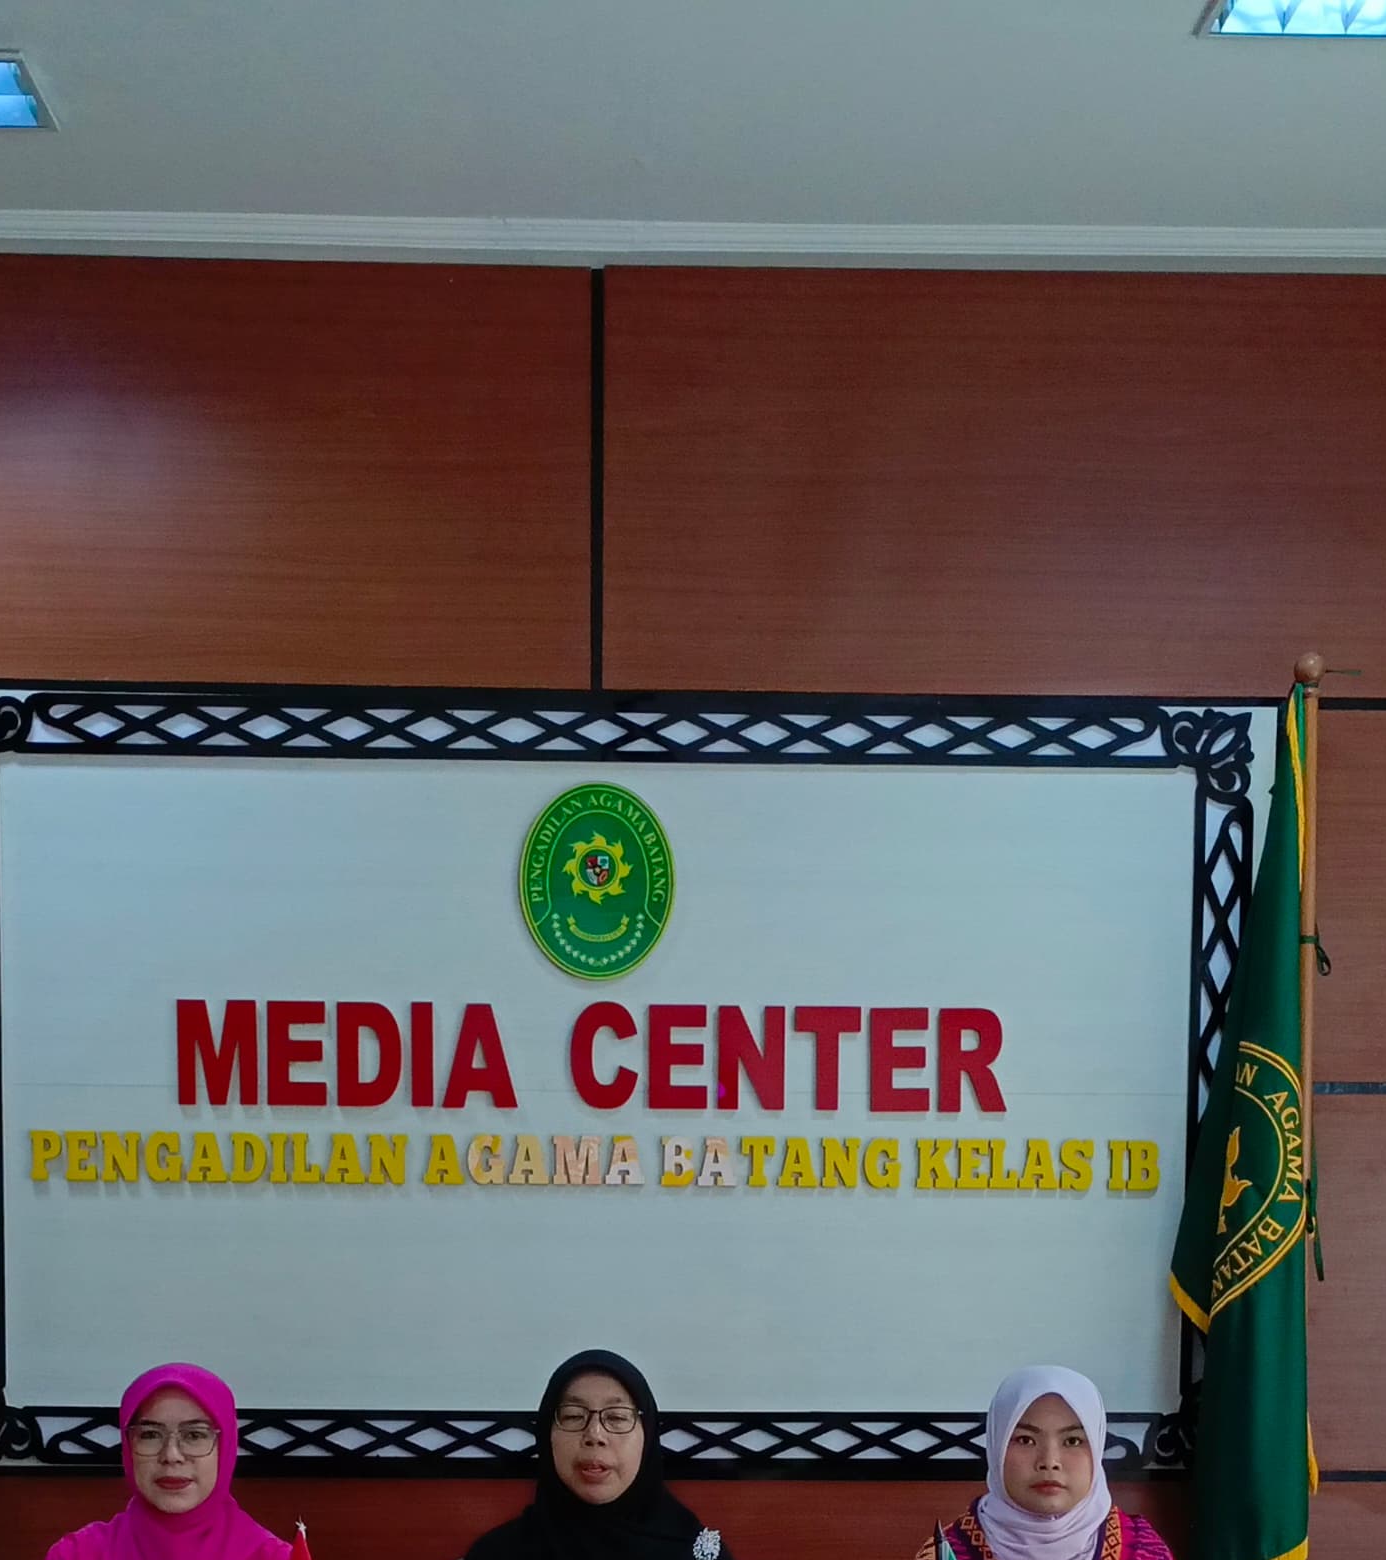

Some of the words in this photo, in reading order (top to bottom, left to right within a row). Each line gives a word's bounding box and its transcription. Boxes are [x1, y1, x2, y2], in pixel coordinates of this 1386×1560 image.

[531, 797, 583, 902] PENGADILAN
[588, 793, 646, 832] AGAMA
[643, 832, 666, 902] BATANG
[176, 999, 518, 1109] MEDIA
[570, 1001, 1007, 1112] CENTER
[29, 1130, 407, 1185] PENGADILAN
[423, 1134, 645, 1187] AGAMA
[661, 1135, 902, 1190] BATANG
[915, 1138, 1094, 1191] KELAS
[1107, 1140, 1160, 1192] IB
[1263, 1091, 1303, 1202] AGAMA
[1212, 1214, 1284, 1297] BATAN
